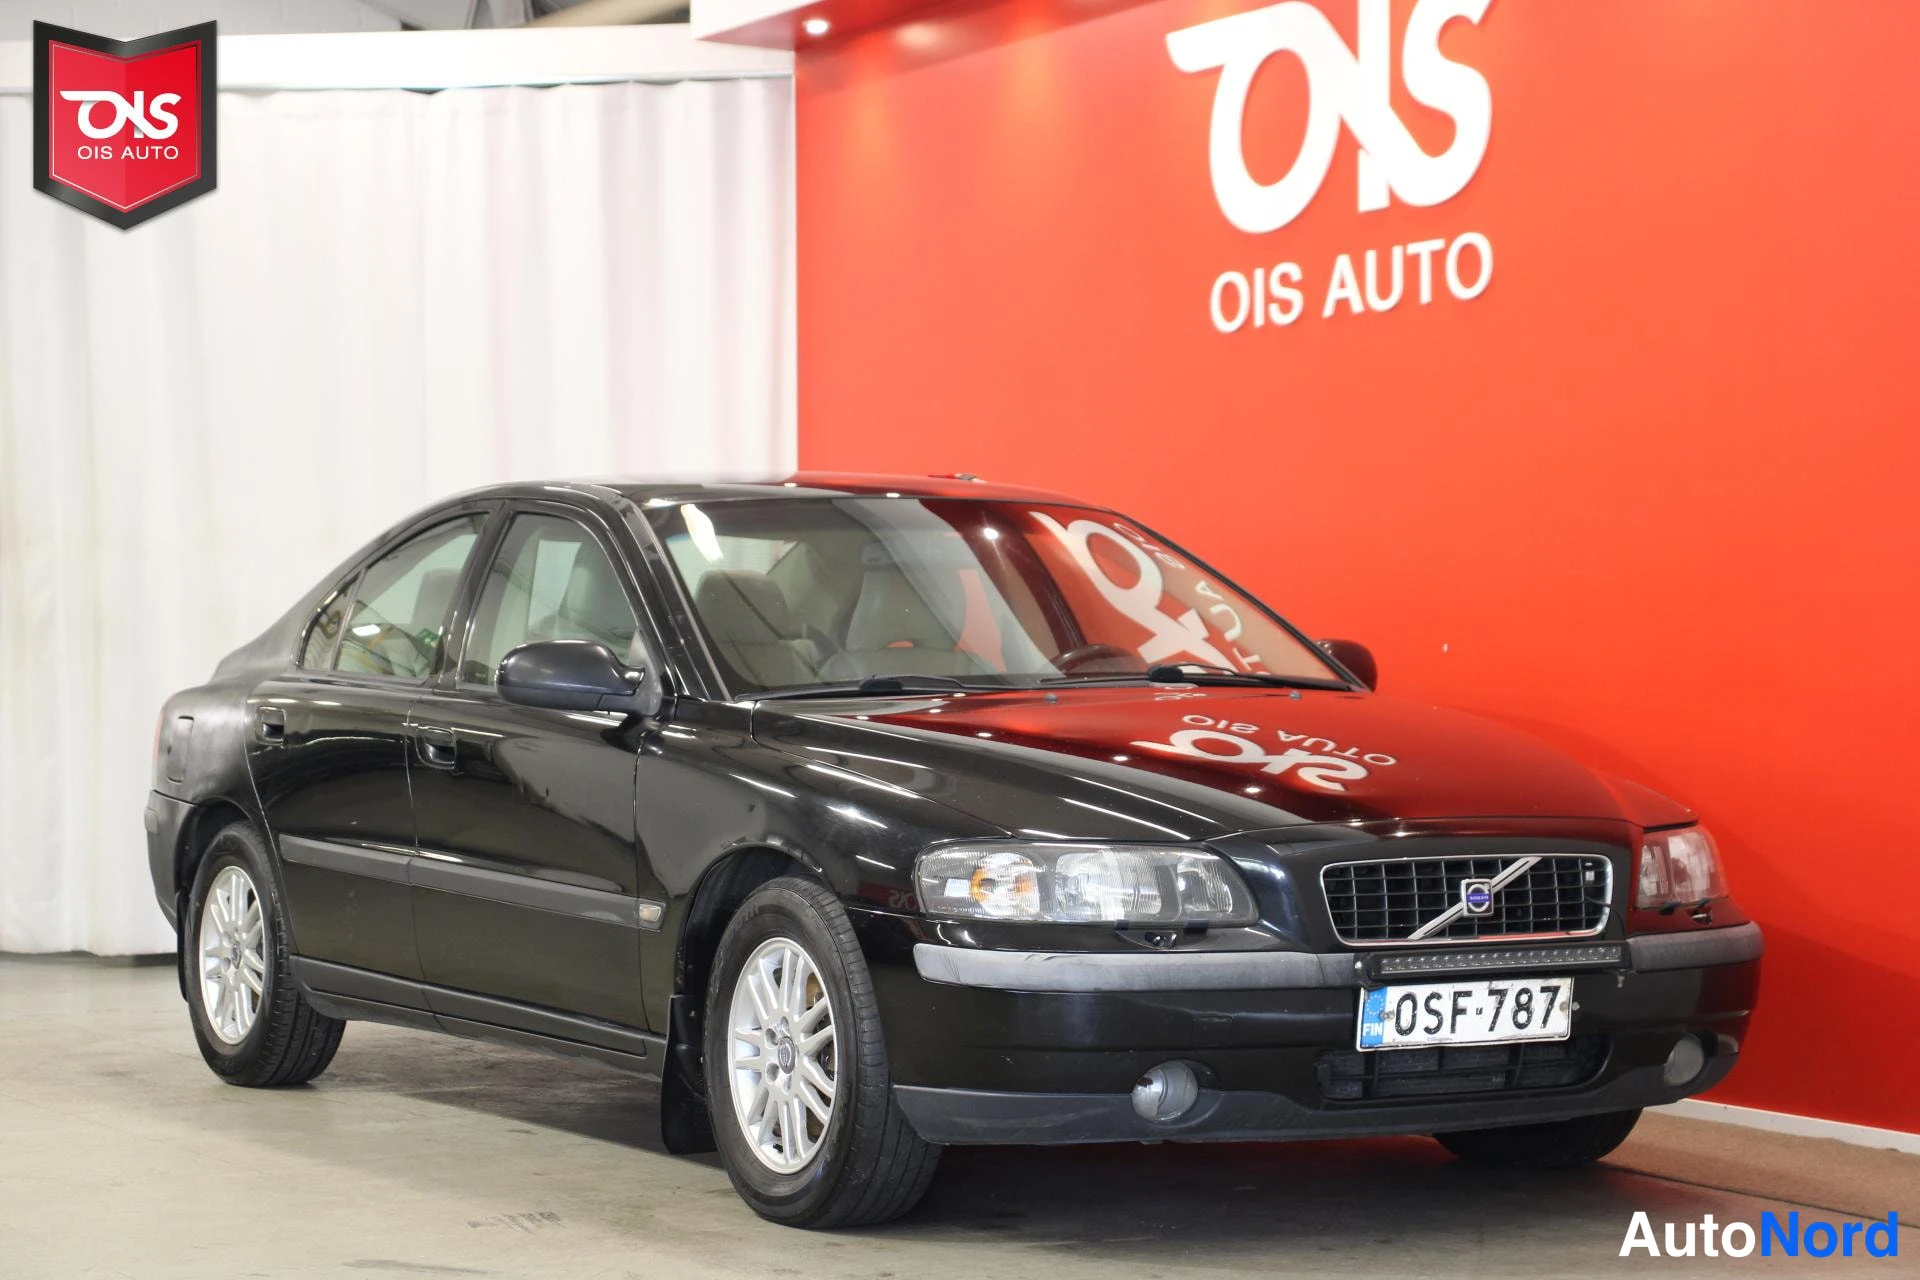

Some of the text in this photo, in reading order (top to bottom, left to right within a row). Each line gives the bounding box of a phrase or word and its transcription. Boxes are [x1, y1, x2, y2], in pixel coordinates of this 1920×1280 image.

[1210, 231, 1494, 334] OIS AUTO
[1362, 1022, 1384, 1037] FIN
[1394, 985, 1561, 1037] OSF-787
